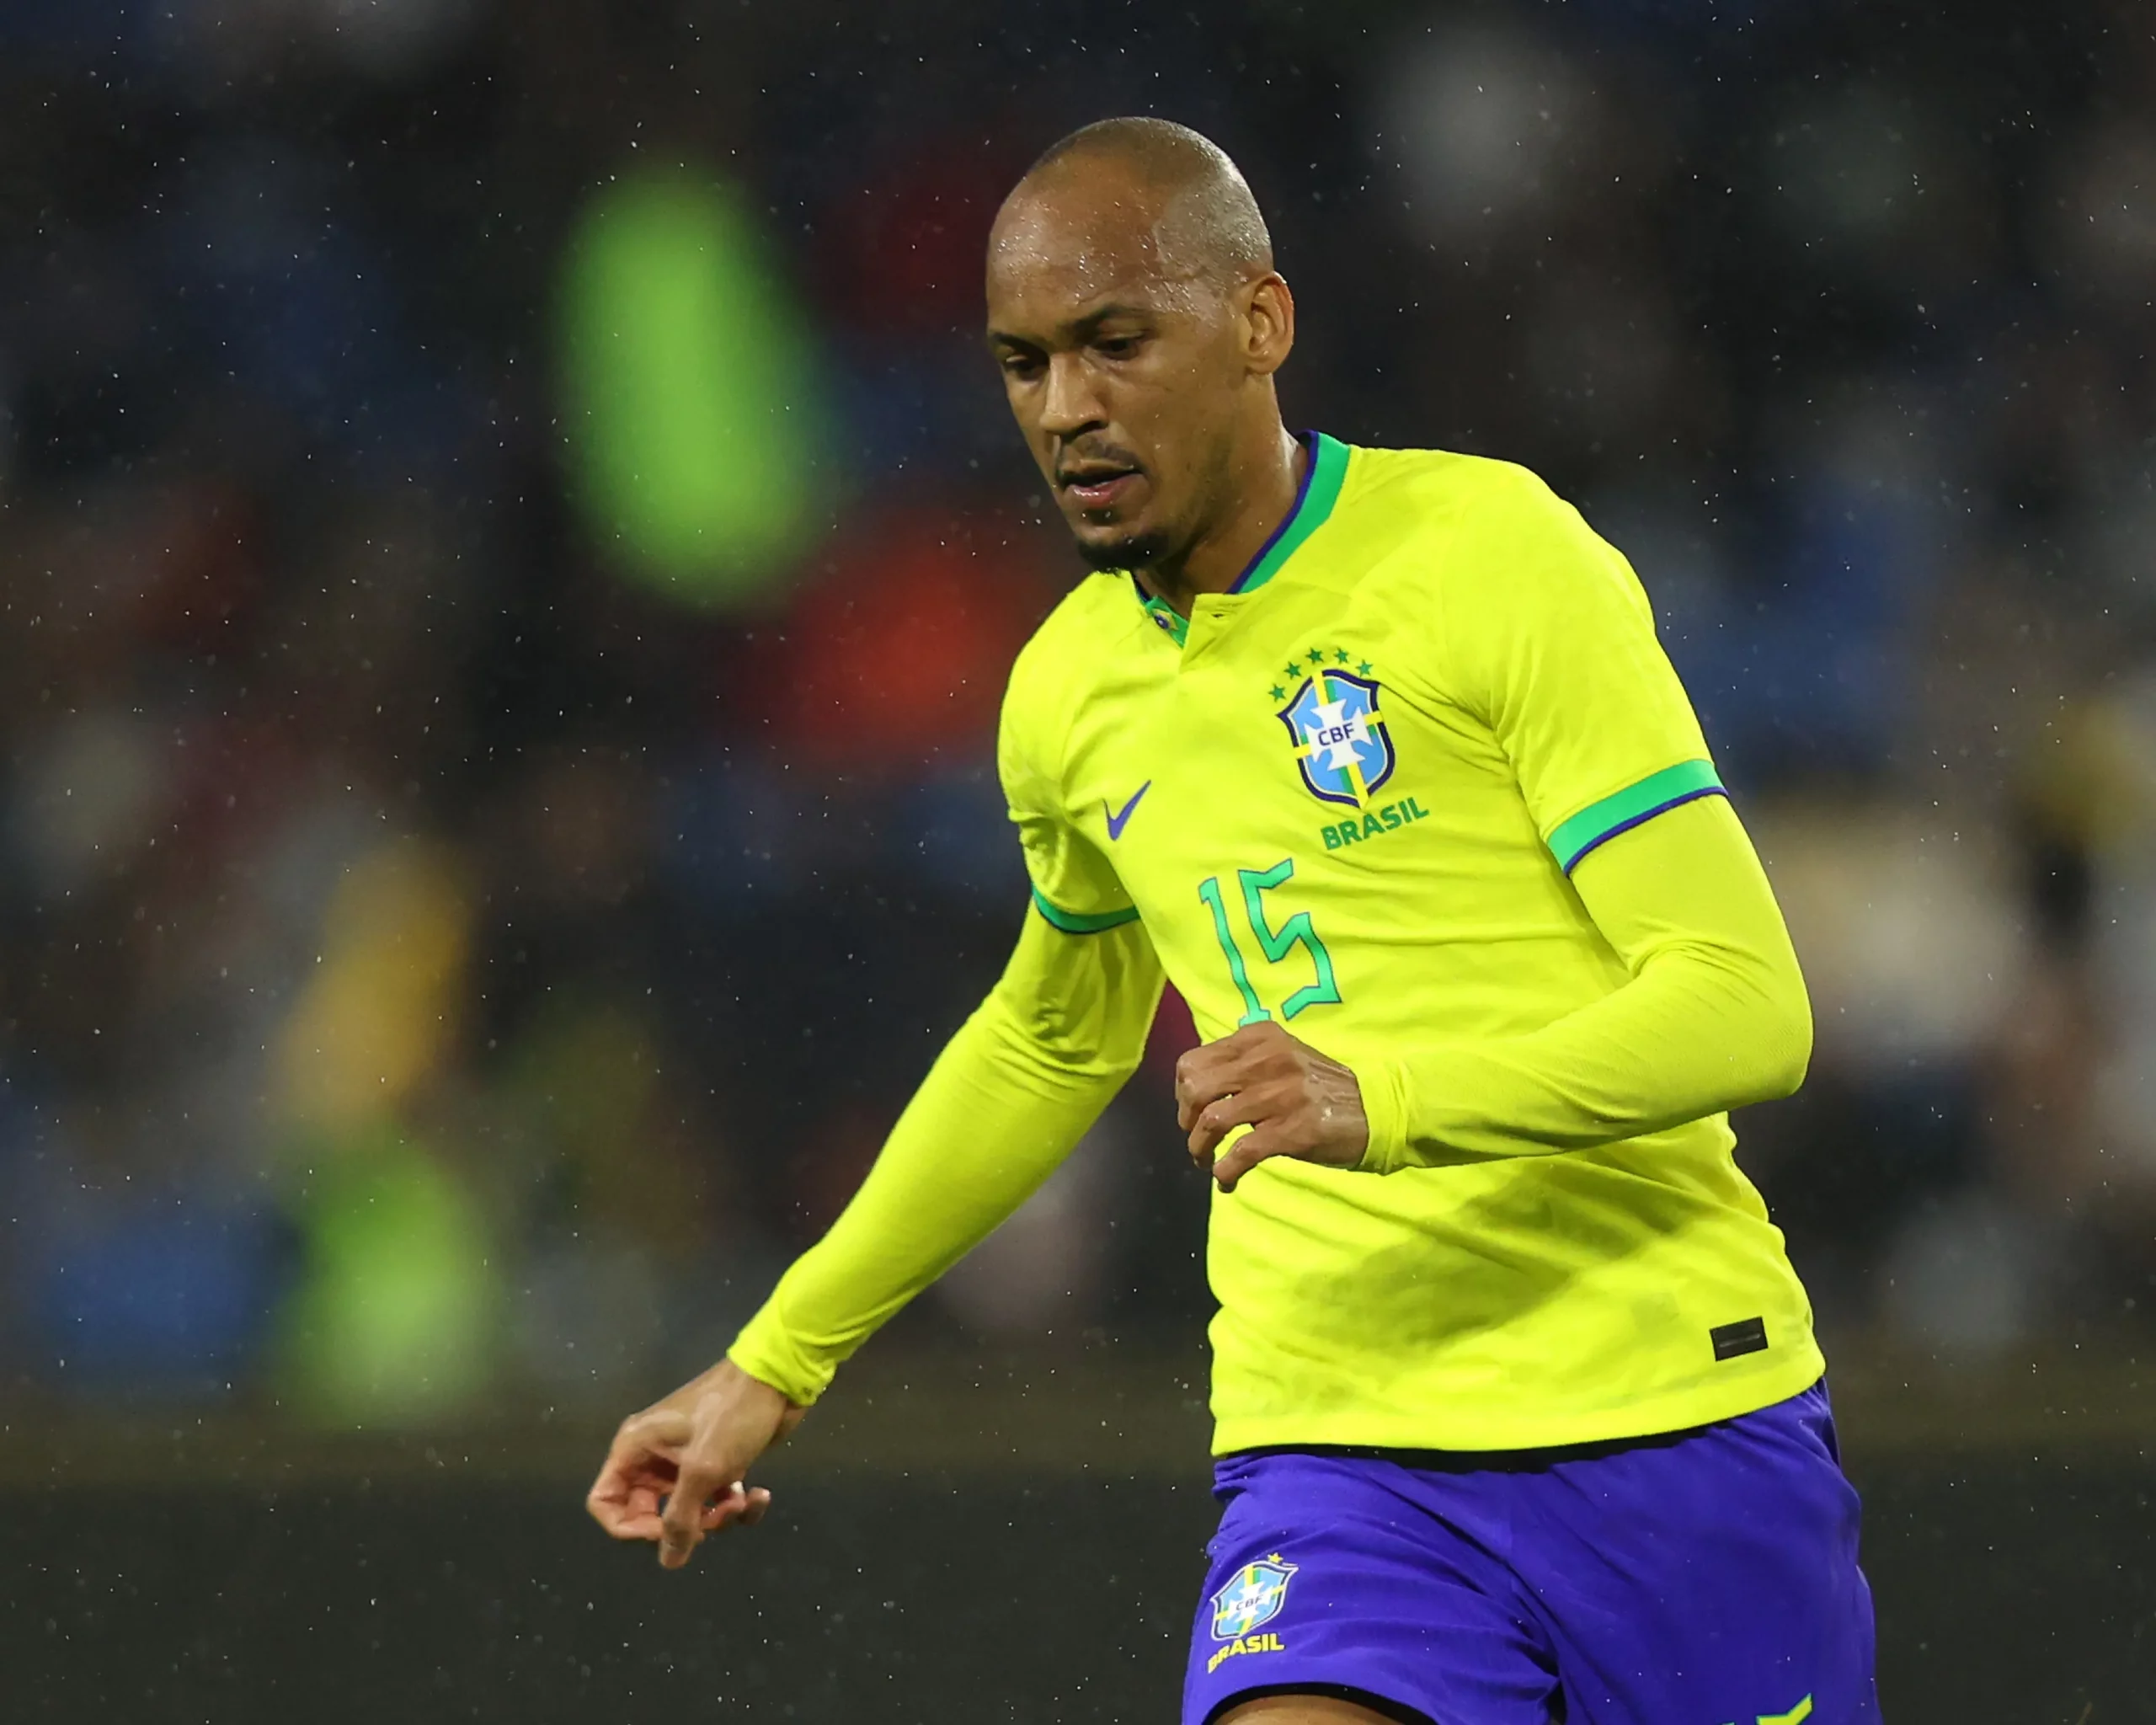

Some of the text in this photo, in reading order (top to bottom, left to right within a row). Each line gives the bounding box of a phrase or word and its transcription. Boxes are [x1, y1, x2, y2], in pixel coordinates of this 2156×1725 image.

[1317, 723, 1355, 746] CBF
[1321, 797, 1430, 851] BRASIL
[1198, 857, 1342, 1027] 15
[1235, 1594, 1264, 1610] CBF
[1208, 1632, 1285, 1674] BRASIL
